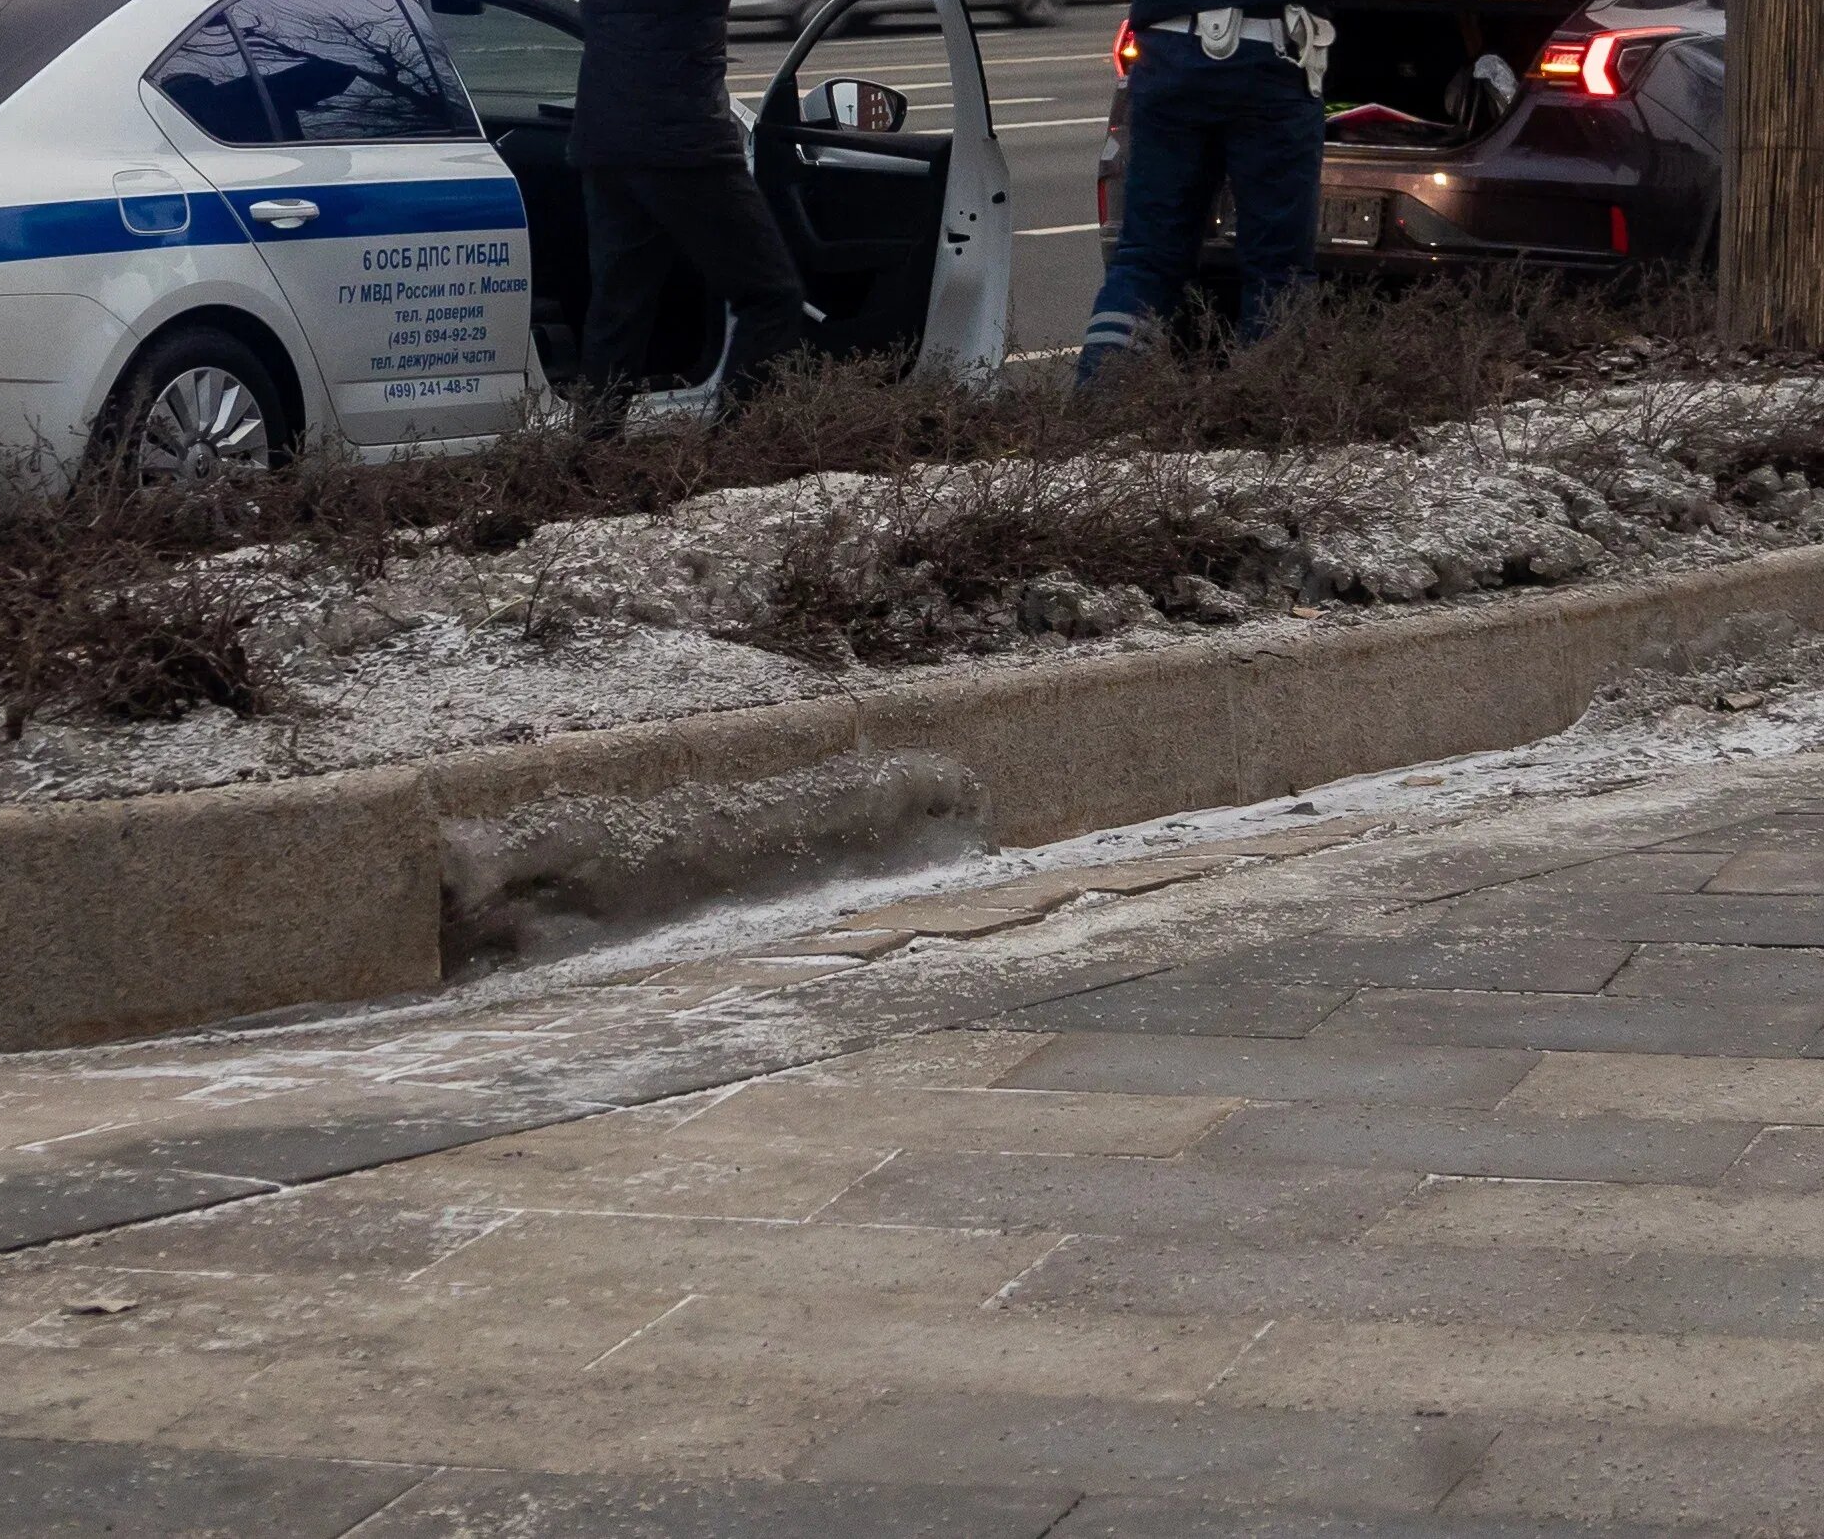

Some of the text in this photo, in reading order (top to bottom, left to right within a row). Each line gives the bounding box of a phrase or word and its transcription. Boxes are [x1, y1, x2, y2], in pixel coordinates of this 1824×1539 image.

[363, 242, 510, 271] 6 ОСБ ДПС ГИБДД
[338, 275, 528, 305] ГУ МВД России по г. Москве
[395, 306, 484, 324] тел. доверия
[388, 326, 487, 349] (495) 694-92-29
[370, 348, 496, 371] тел. дежурной части
[384, 378, 480, 402] (499) 241-48-57
